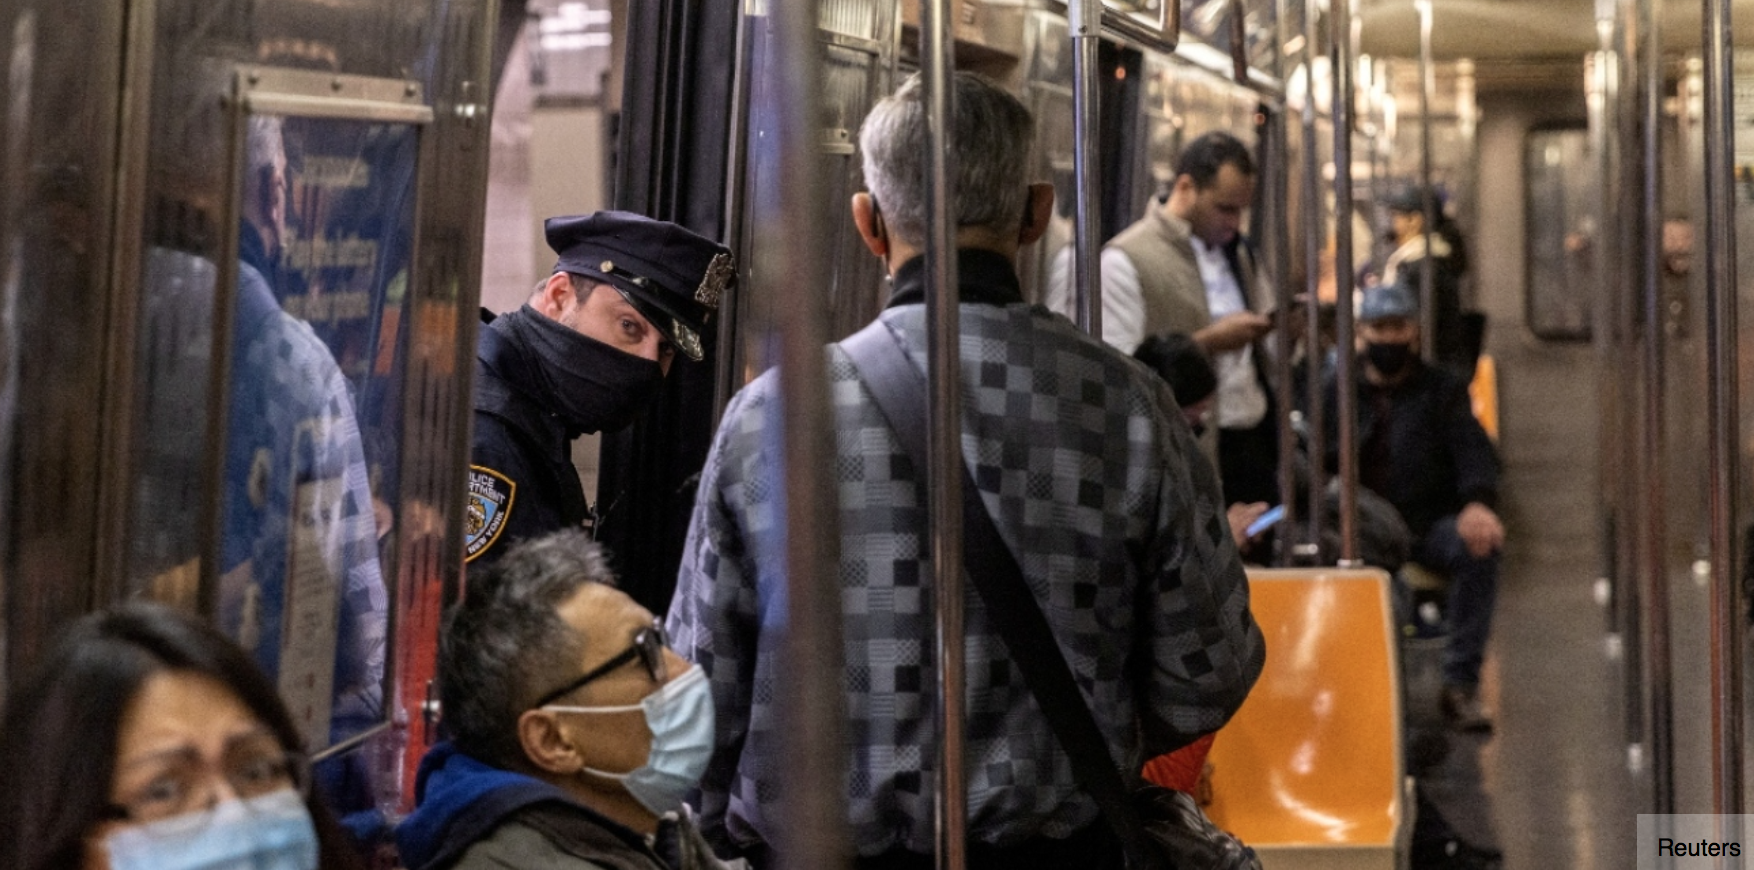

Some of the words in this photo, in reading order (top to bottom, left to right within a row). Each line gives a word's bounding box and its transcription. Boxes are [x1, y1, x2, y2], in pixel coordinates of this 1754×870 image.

[469, 471, 495, 488] LICE
[467, 536, 487, 554] NEW
[486, 511, 504, 537] YORK
